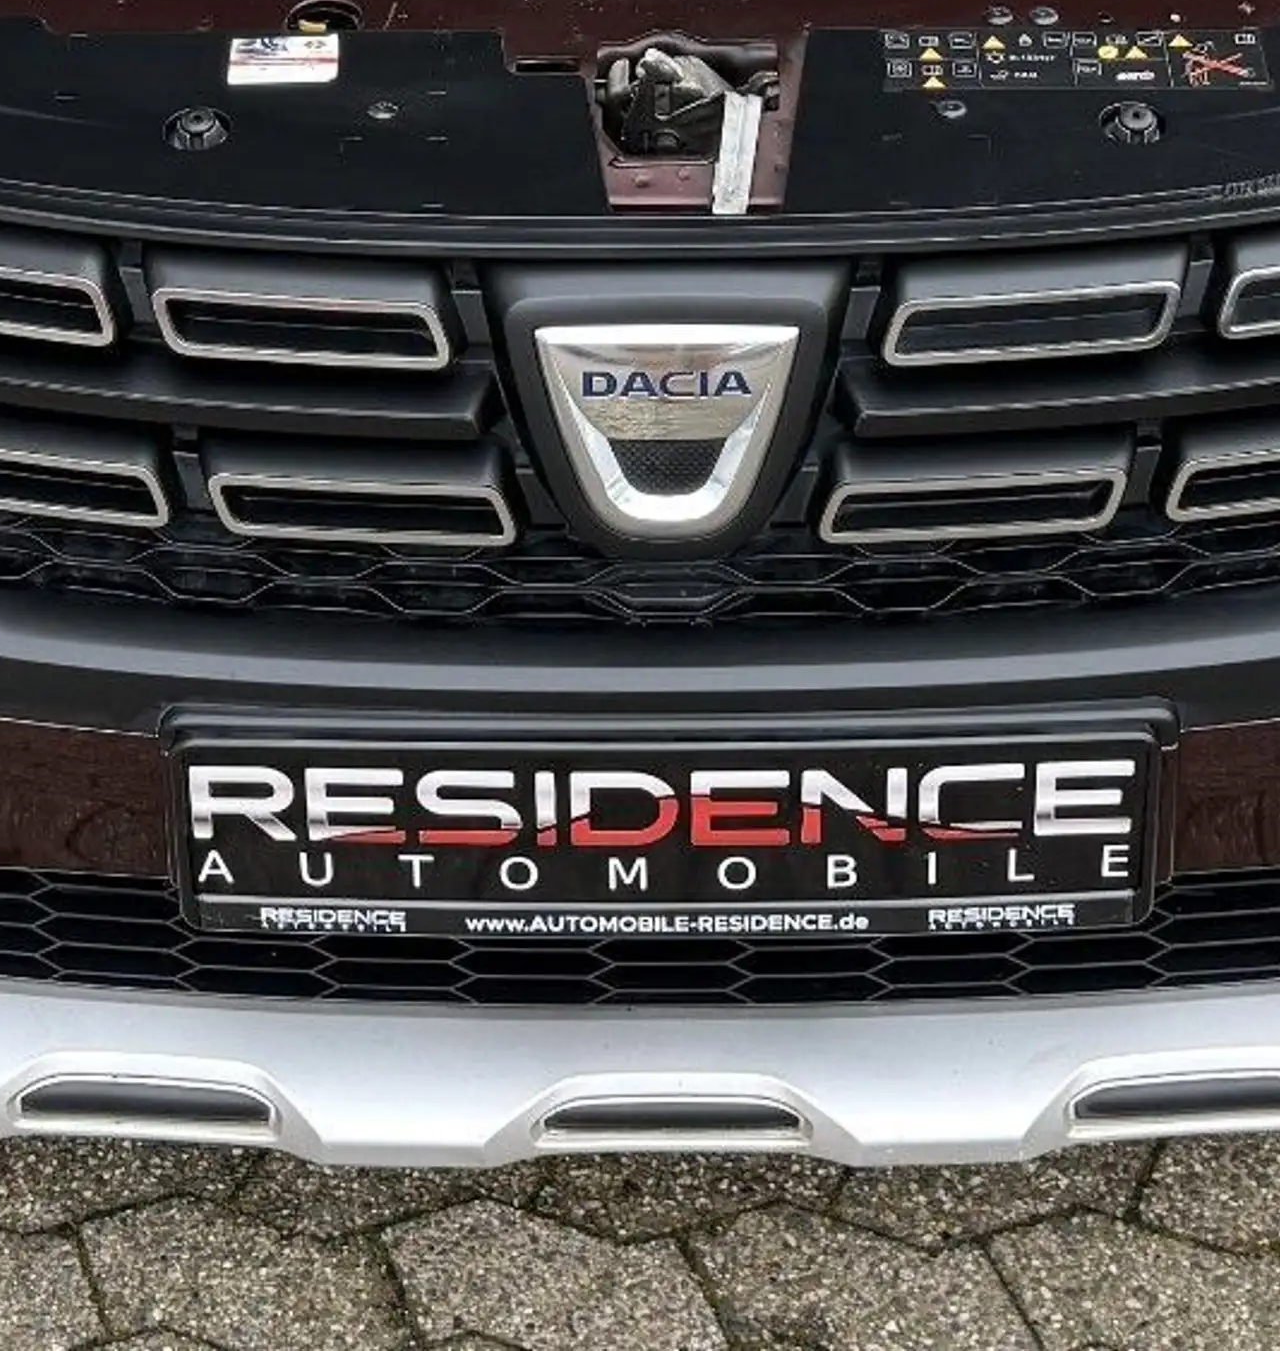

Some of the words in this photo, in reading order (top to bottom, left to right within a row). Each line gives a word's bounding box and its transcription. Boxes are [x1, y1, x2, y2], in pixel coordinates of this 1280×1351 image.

[581, 371, 752, 397] DACIA
[189, 759, 1135, 846] RESIDENCE
[198, 844, 1131, 891] AUTOMOBILE
[260, 907, 406, 925] RESIDENCE
[465, 913, 869, 935] www.AUTOMOBILE-RESIDENCE.de
[928, 903, 1075, 923] RESIDENCE
